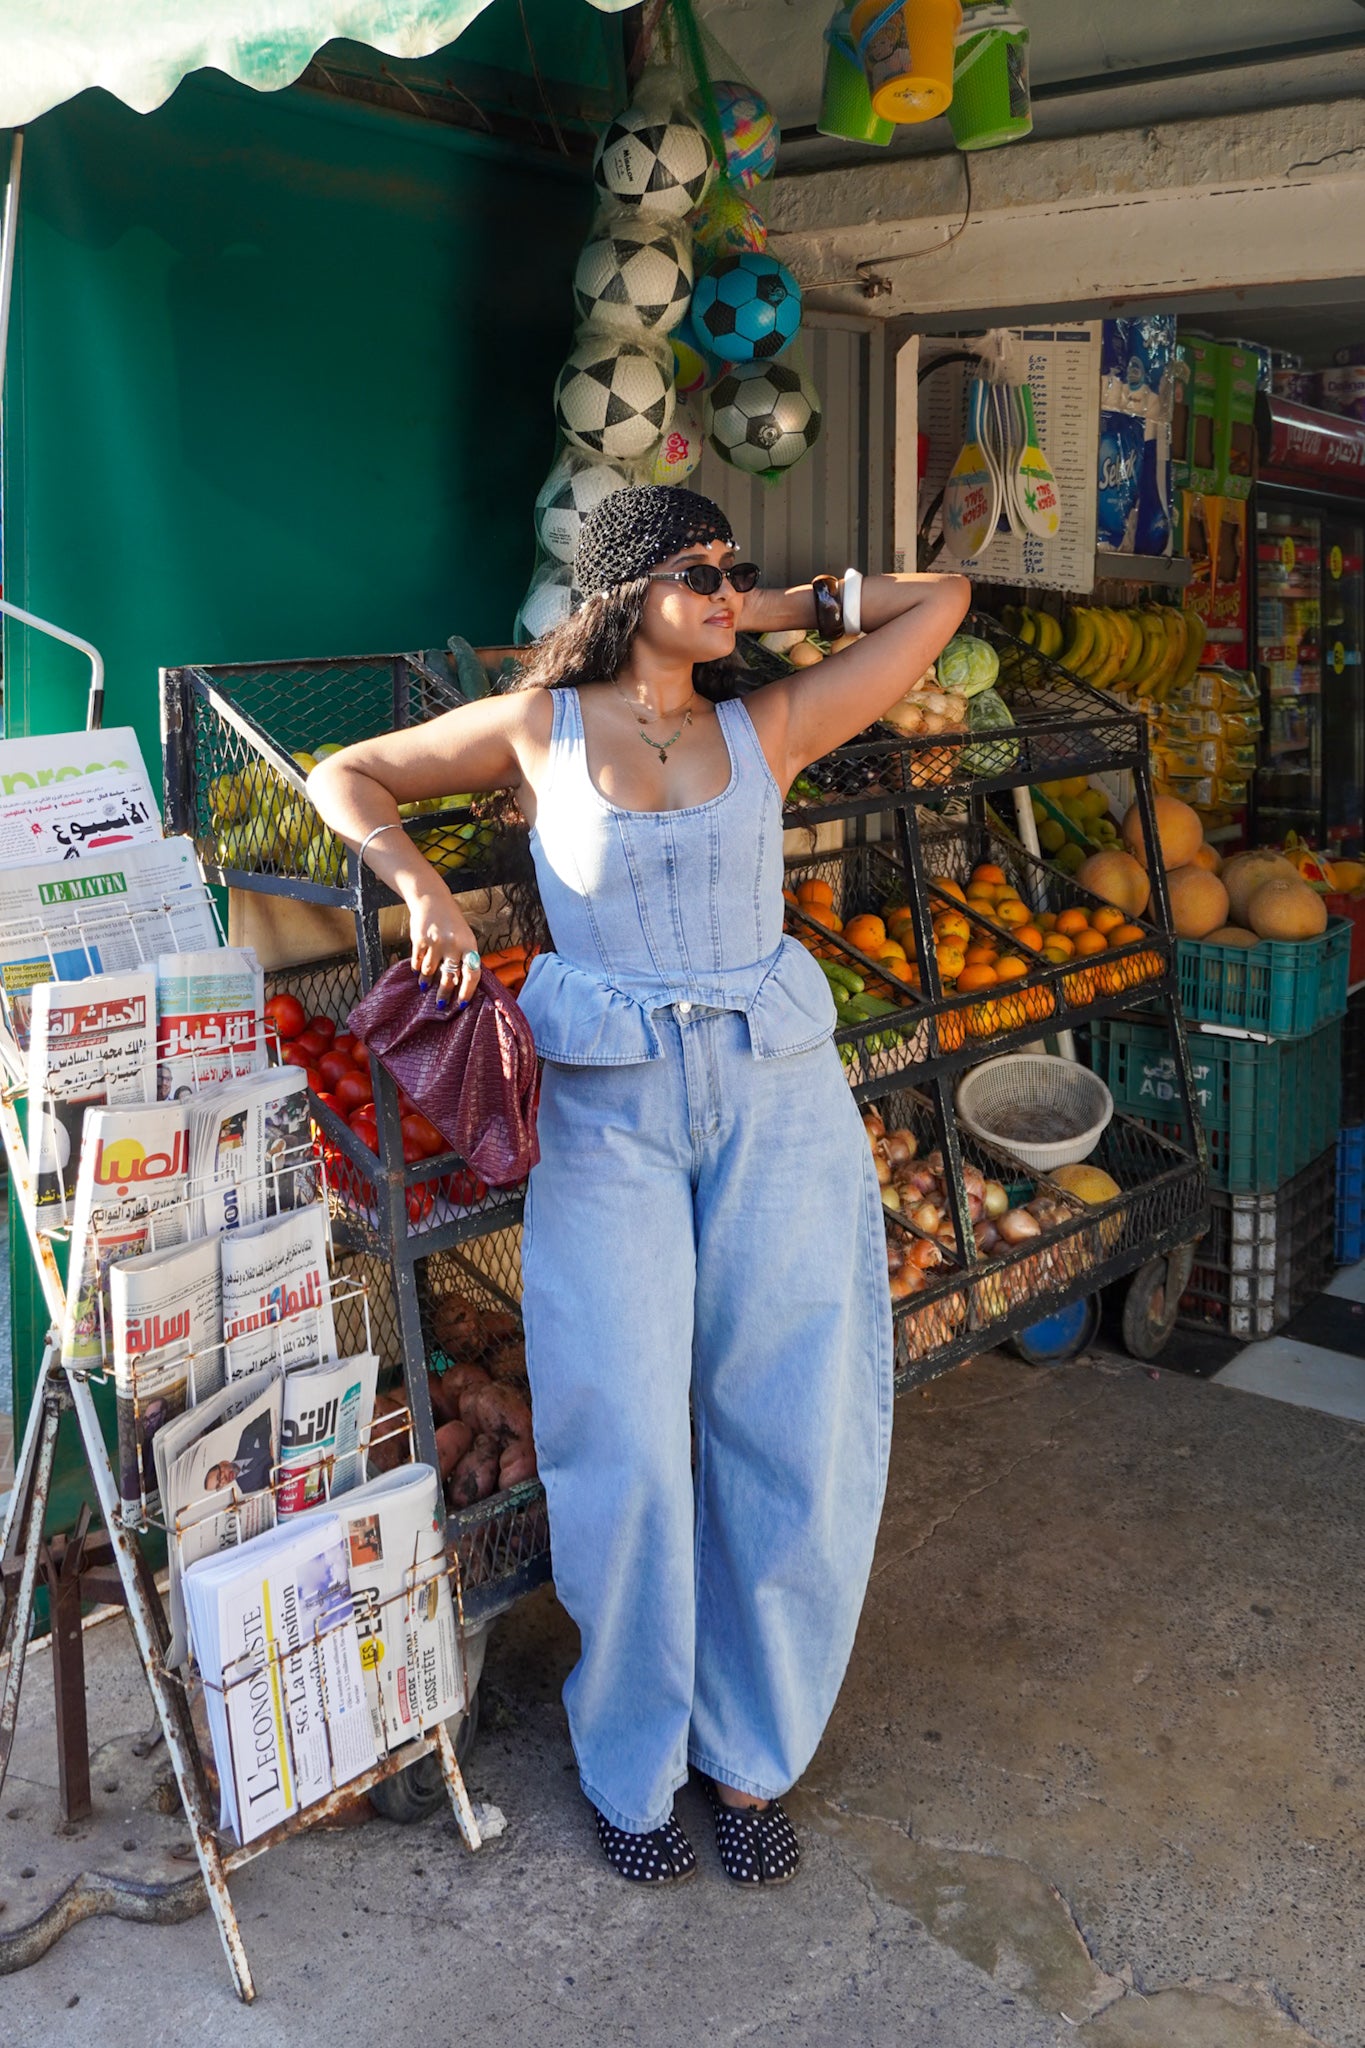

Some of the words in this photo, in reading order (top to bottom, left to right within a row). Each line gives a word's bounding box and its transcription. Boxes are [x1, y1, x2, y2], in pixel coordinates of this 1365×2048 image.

[52, 797, 149, 845] الأسبوع
[42, 884, 67, 903] LE
[125, 1309, 190, 1354] رسالة
[362, 1644, 377, 1667] LES
[289, 1676, 307, 1705] La
[421, 1646, 438, 1711] CASSE-TÊTE
[243, 1606, 280, 1808] L'ECONOMISTE
[295, 1705, 310, 1735] 5G:
